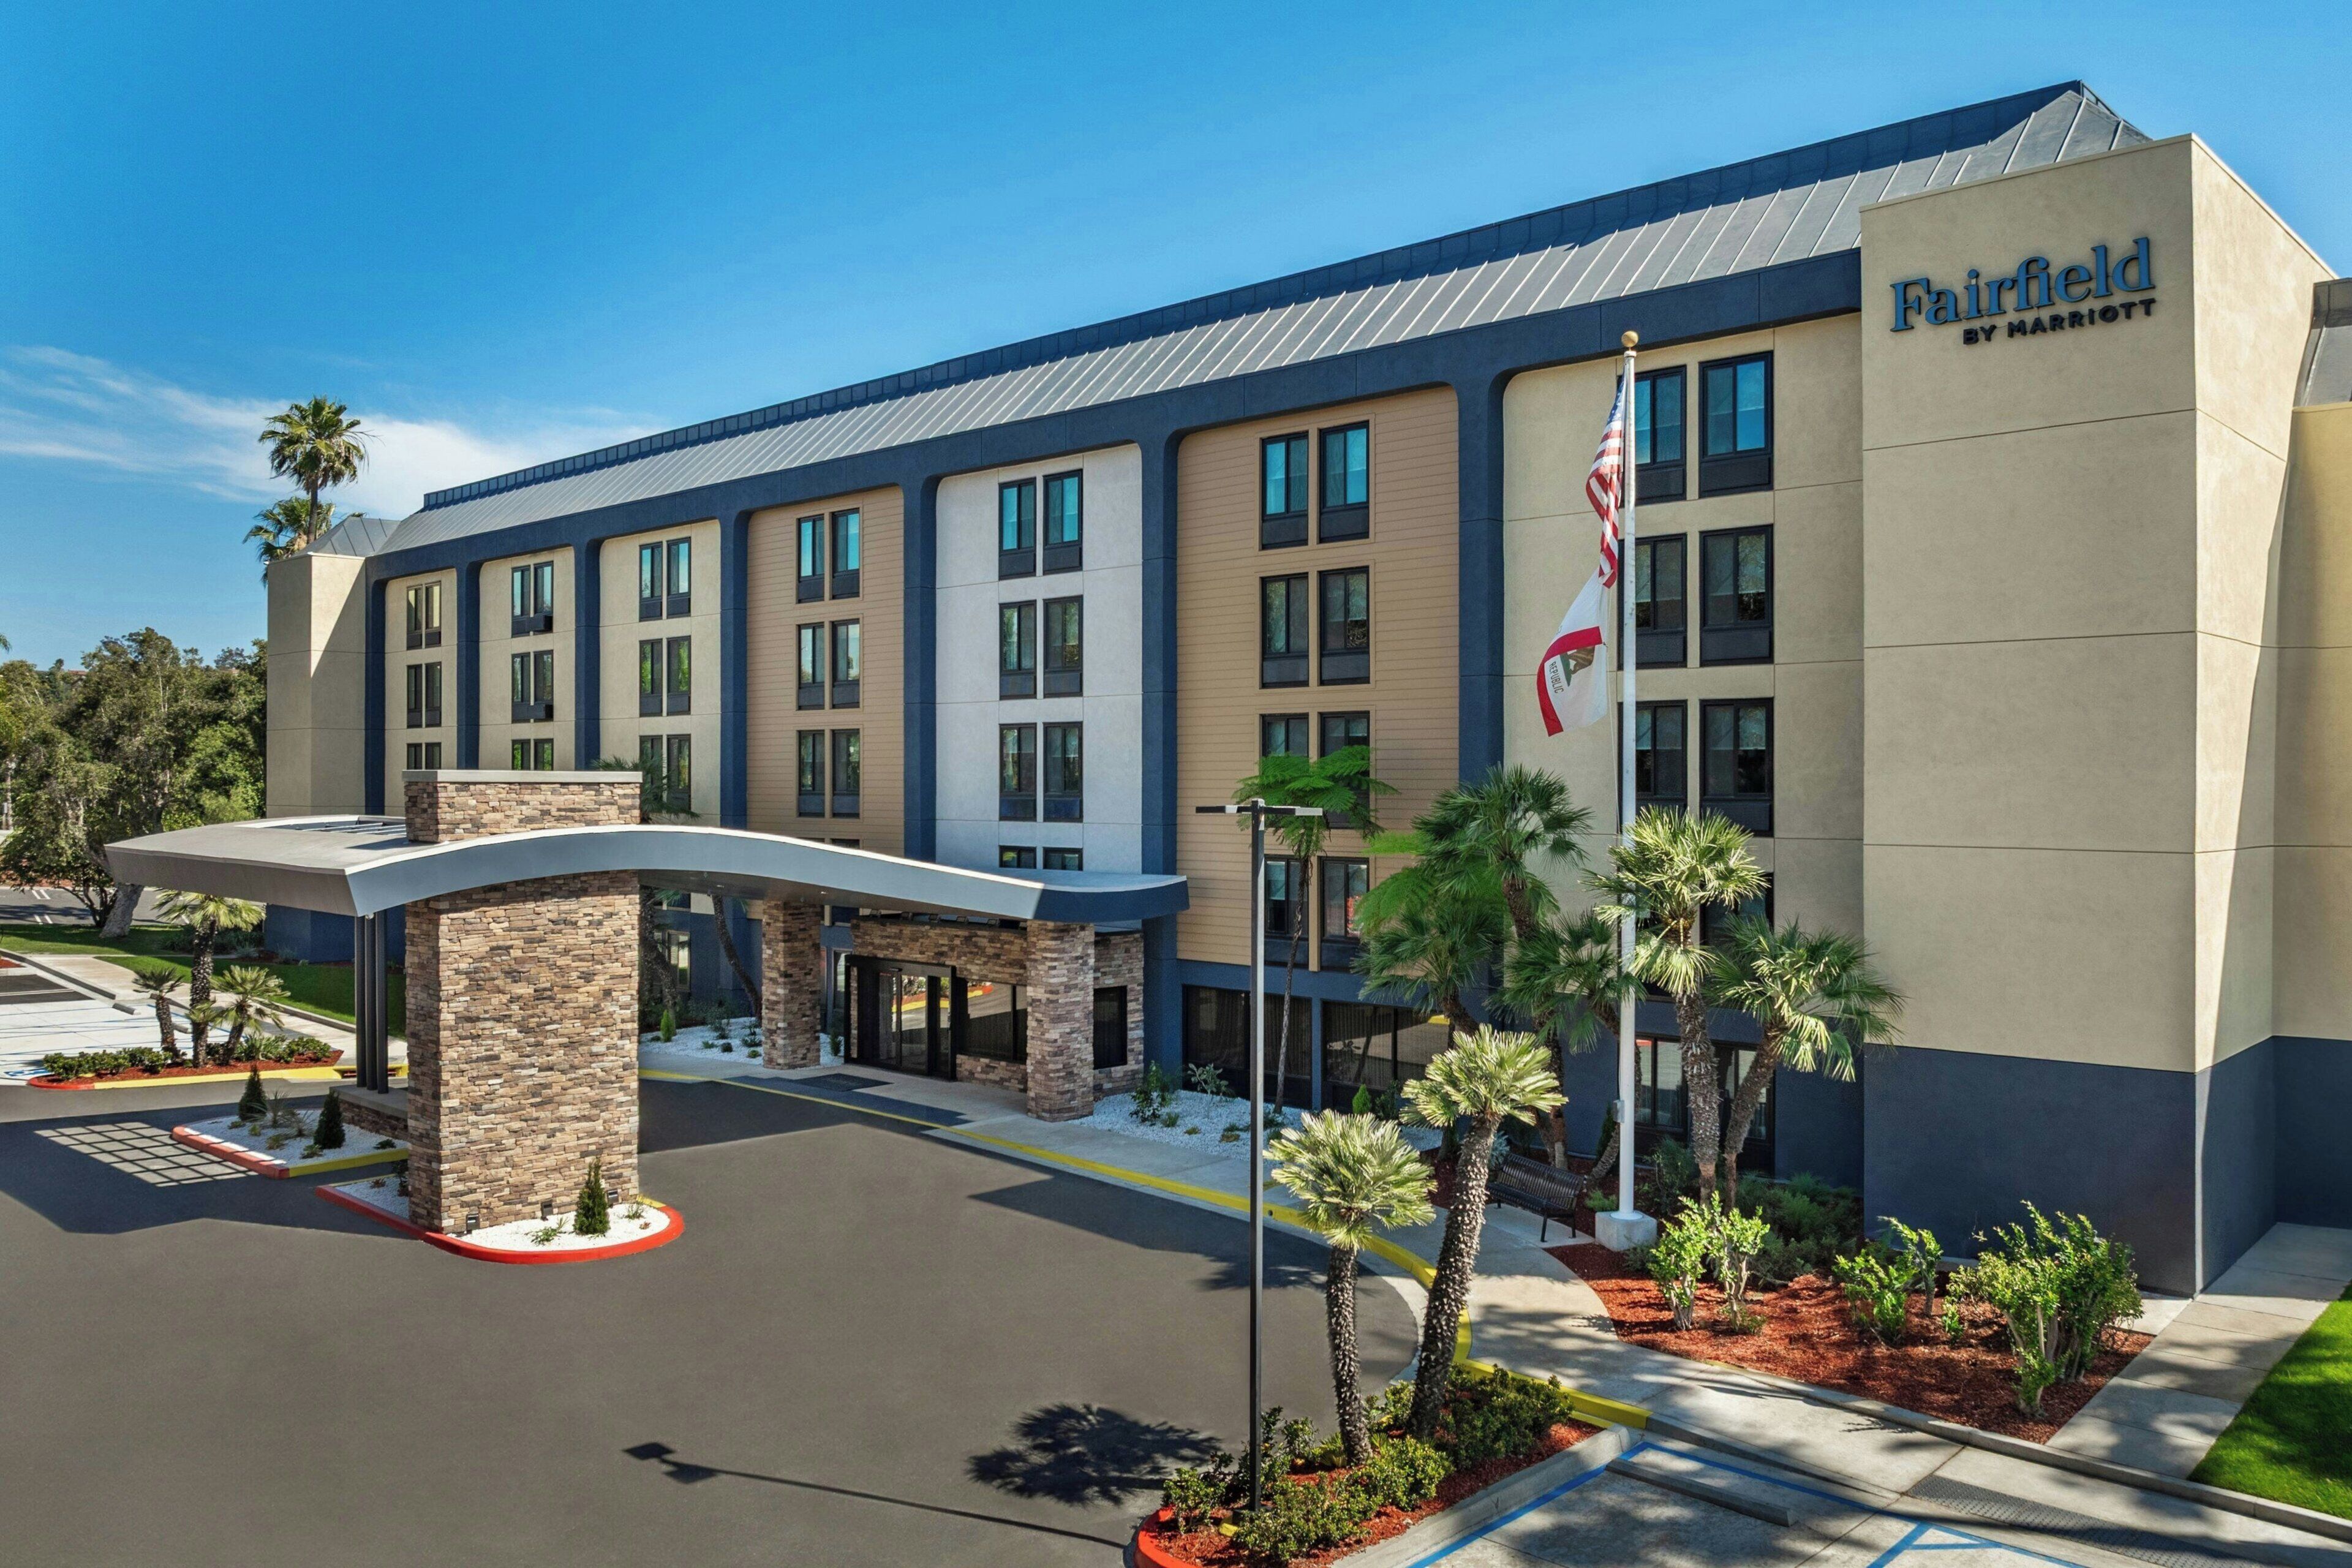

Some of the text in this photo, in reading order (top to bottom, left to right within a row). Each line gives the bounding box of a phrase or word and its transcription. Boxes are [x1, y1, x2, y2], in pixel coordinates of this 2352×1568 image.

[1890, 237, 2155, 332] Fairfield
[1963, 298, 2156, 345] BY MARRIOTT
[1549, 661, 1564, 693] REPUBLIC
